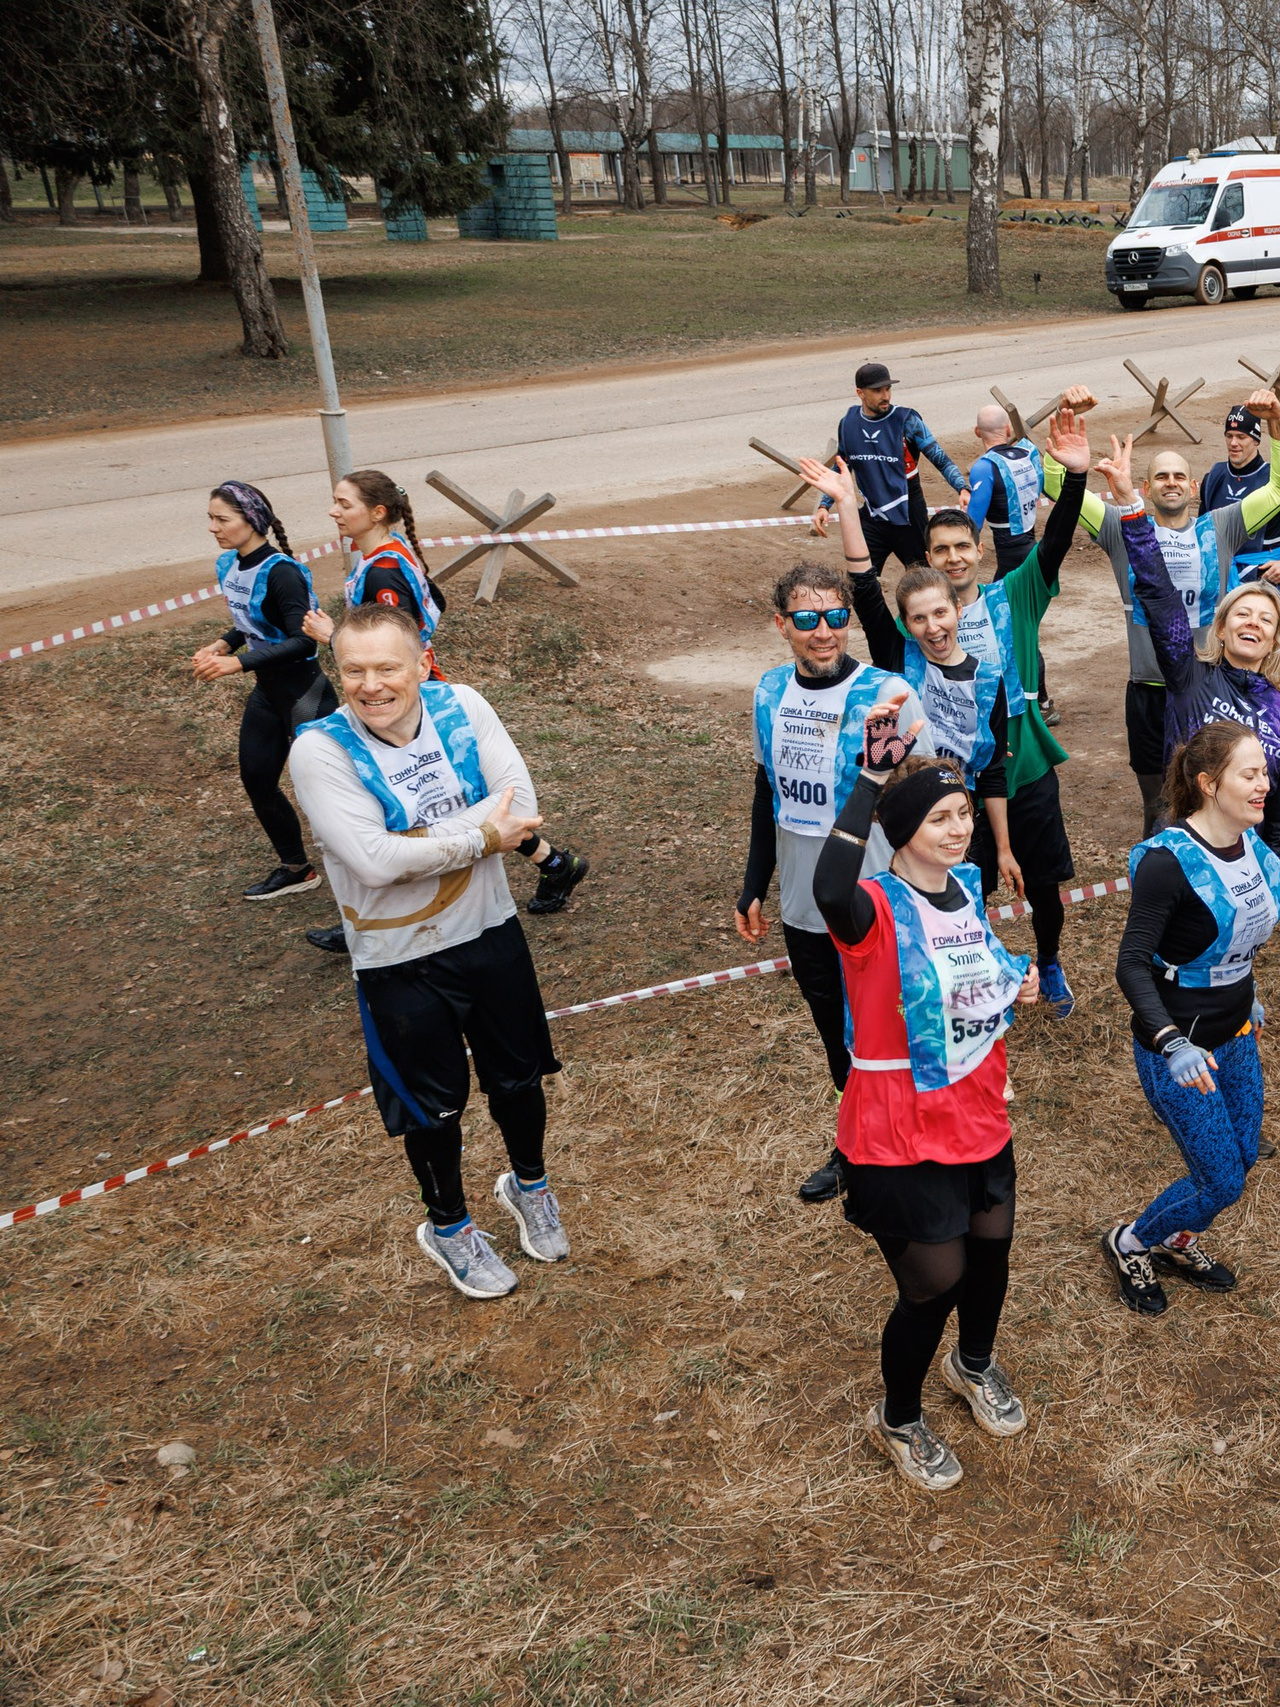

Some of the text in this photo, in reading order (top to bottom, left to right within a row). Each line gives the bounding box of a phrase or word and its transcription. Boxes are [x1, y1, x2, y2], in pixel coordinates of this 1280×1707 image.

[963, 618, 988, 628] ГЕРОЕВ
[780, 707, 838, 721] ГОНКА ГЕРОЕВ
[932, 697, 967, 720] Sminex
[783, 721, 826, 738] Sminex
[779, 776, 827, 806] 5400
[1231, 882, 1252, 894] ГОНКА
[932, 935, 962, 946] ГОНКА
